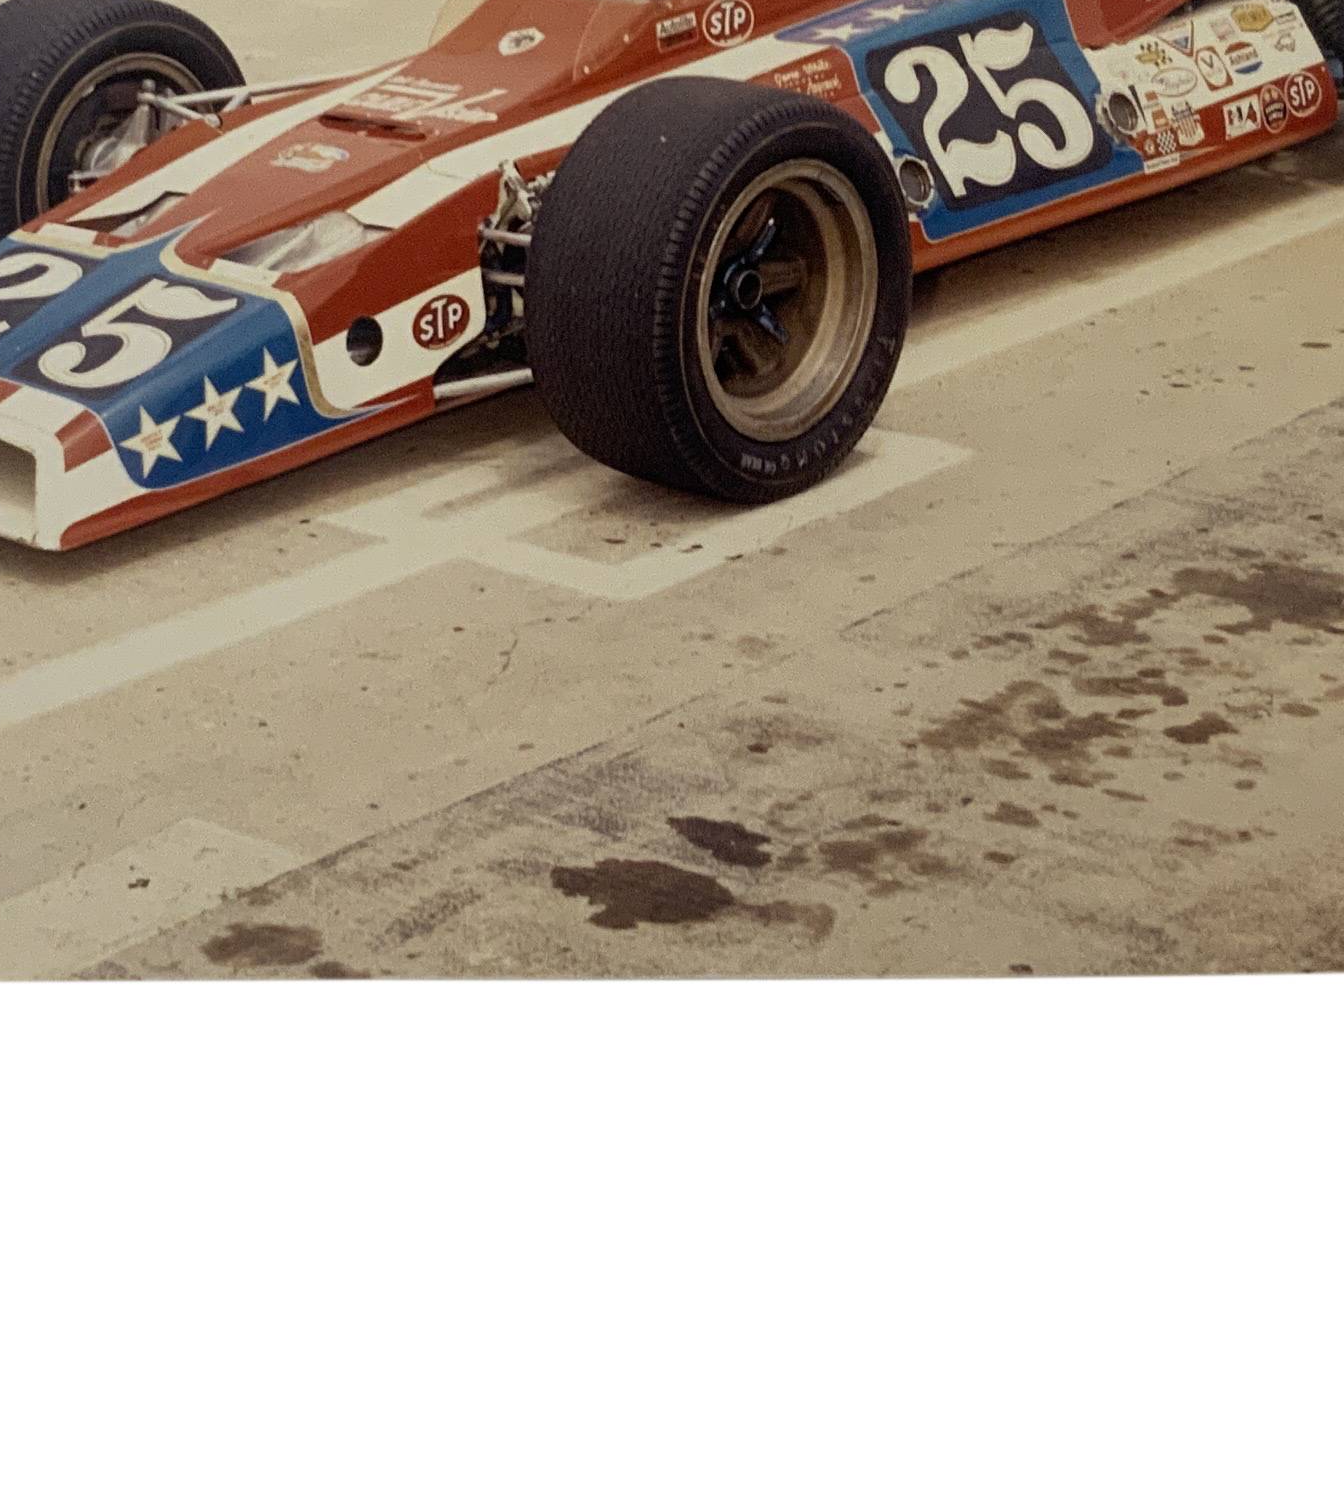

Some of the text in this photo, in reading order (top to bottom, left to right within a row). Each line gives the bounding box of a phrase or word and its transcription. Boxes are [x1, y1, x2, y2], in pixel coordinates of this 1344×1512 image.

[710, 1, 747, 36] STP
[884, 21, 1094, 198] 25
[1289, 75, 1316, 107] STP
[419, 297, 463, 341] STP
